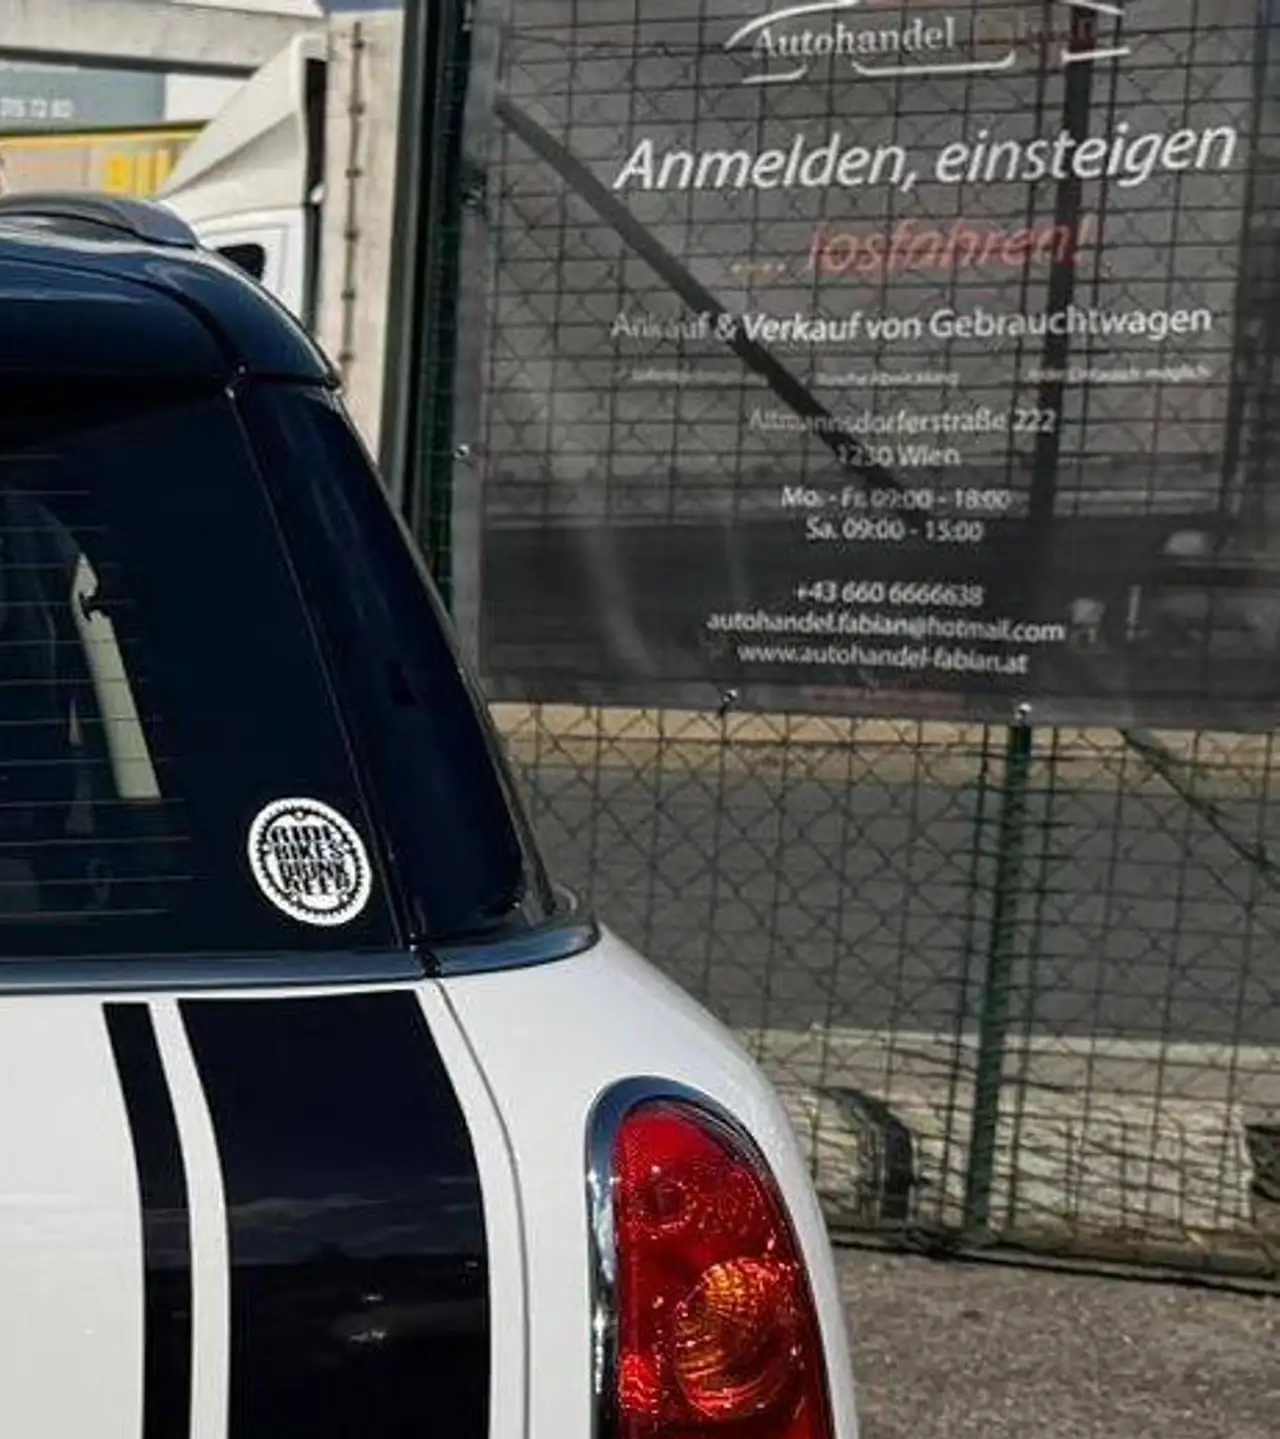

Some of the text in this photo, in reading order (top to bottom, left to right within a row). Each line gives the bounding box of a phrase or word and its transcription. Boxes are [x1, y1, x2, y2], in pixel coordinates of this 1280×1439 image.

[751, 17, 956, 60] Autohandel
[611, 121, 1237, 193] Anmelden, einsteigen
[808, 217, 1093, 272] losfahren!
[611, 305, 1213, 342] Ankauf & Verkauf von Gebrauchtwagen
[1013, 408, 1055, 432] 222
[838, 443, 961, 467] 1230 Wien
[781, 486, 823, 508] Mo.
[870, 488, 933, 509] 09:00
[954, 489, 1013, 510] 18:00
[805, 517, 838, 540] Sa.
[842, 518, 906, 540] 09:00
[925, 520, 985, 543] 15:00
[796, 581, 837, 602] +43
[841, 581, 885, 603] 660
[706, 610, 1066, 643] autohandel.fabian@hotmail.com
[736, 643, 1030, 675] www.autohandel-fabian.at
